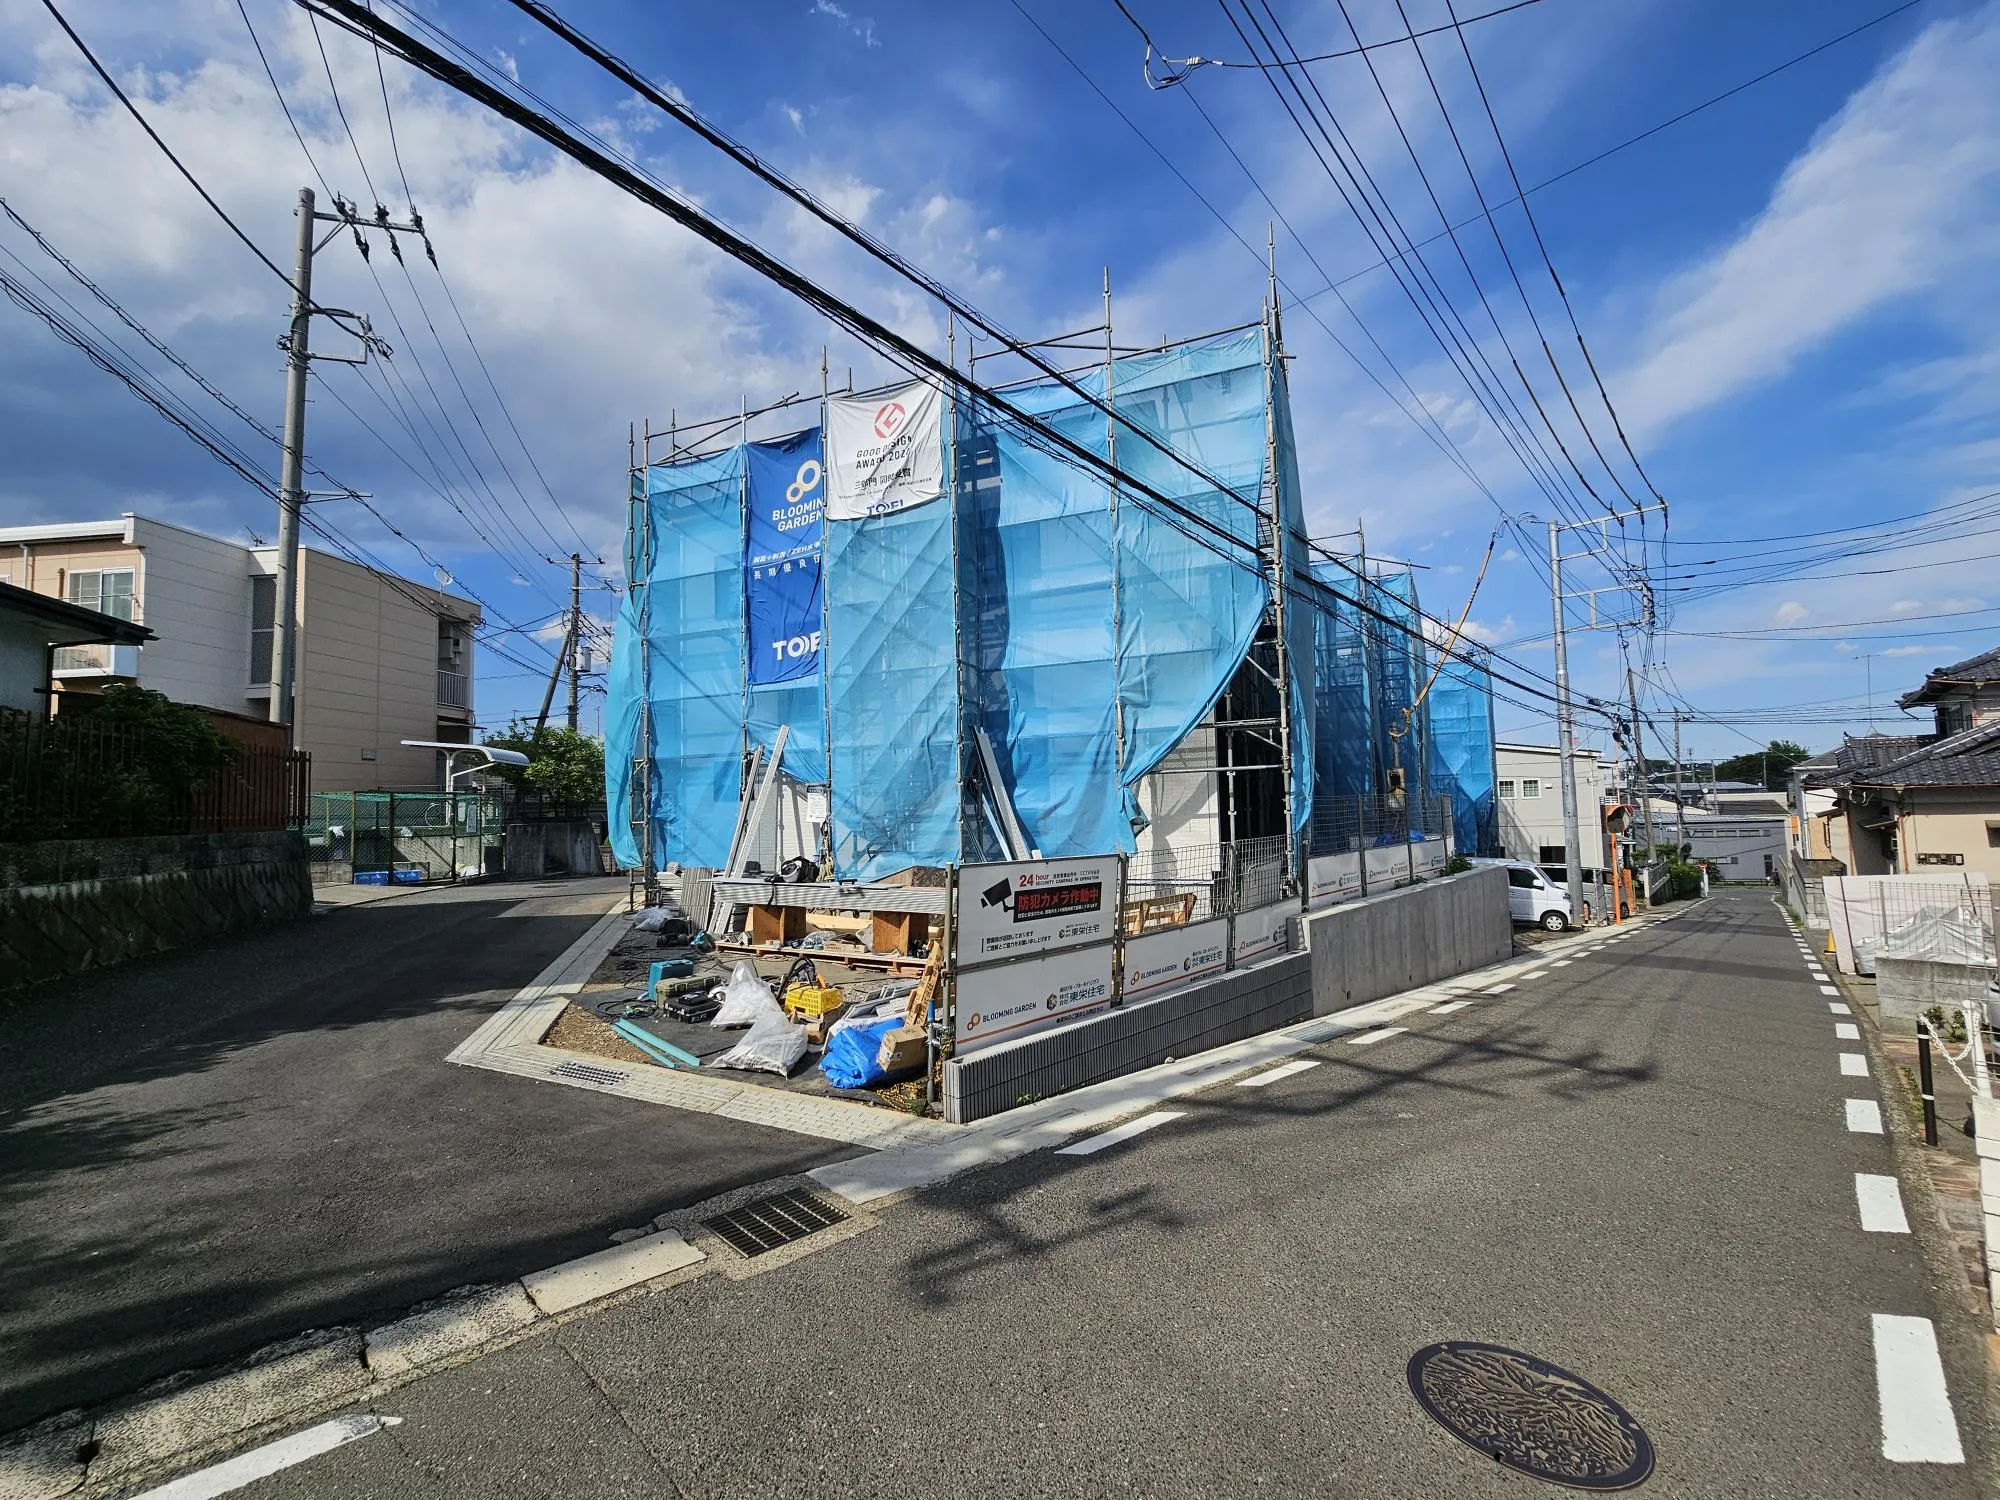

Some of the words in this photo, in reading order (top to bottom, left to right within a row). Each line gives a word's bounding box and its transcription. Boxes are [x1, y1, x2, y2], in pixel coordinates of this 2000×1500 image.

[856, 447, 881, 458] GOOD
[772, 498, 823, 520] BLOOMIN
[772, 631, 821, 660] TOE
[1019, 874, 1034, 887] 24
[1018, 887, 1099, 912] 防犯カメラ作動中
[1069, 984, 1105, 1002] 東栄住宅
[982, 1008, 1014, 1022] BLOOMING
[1014, 1001, 1037, 1014] GARDEN
